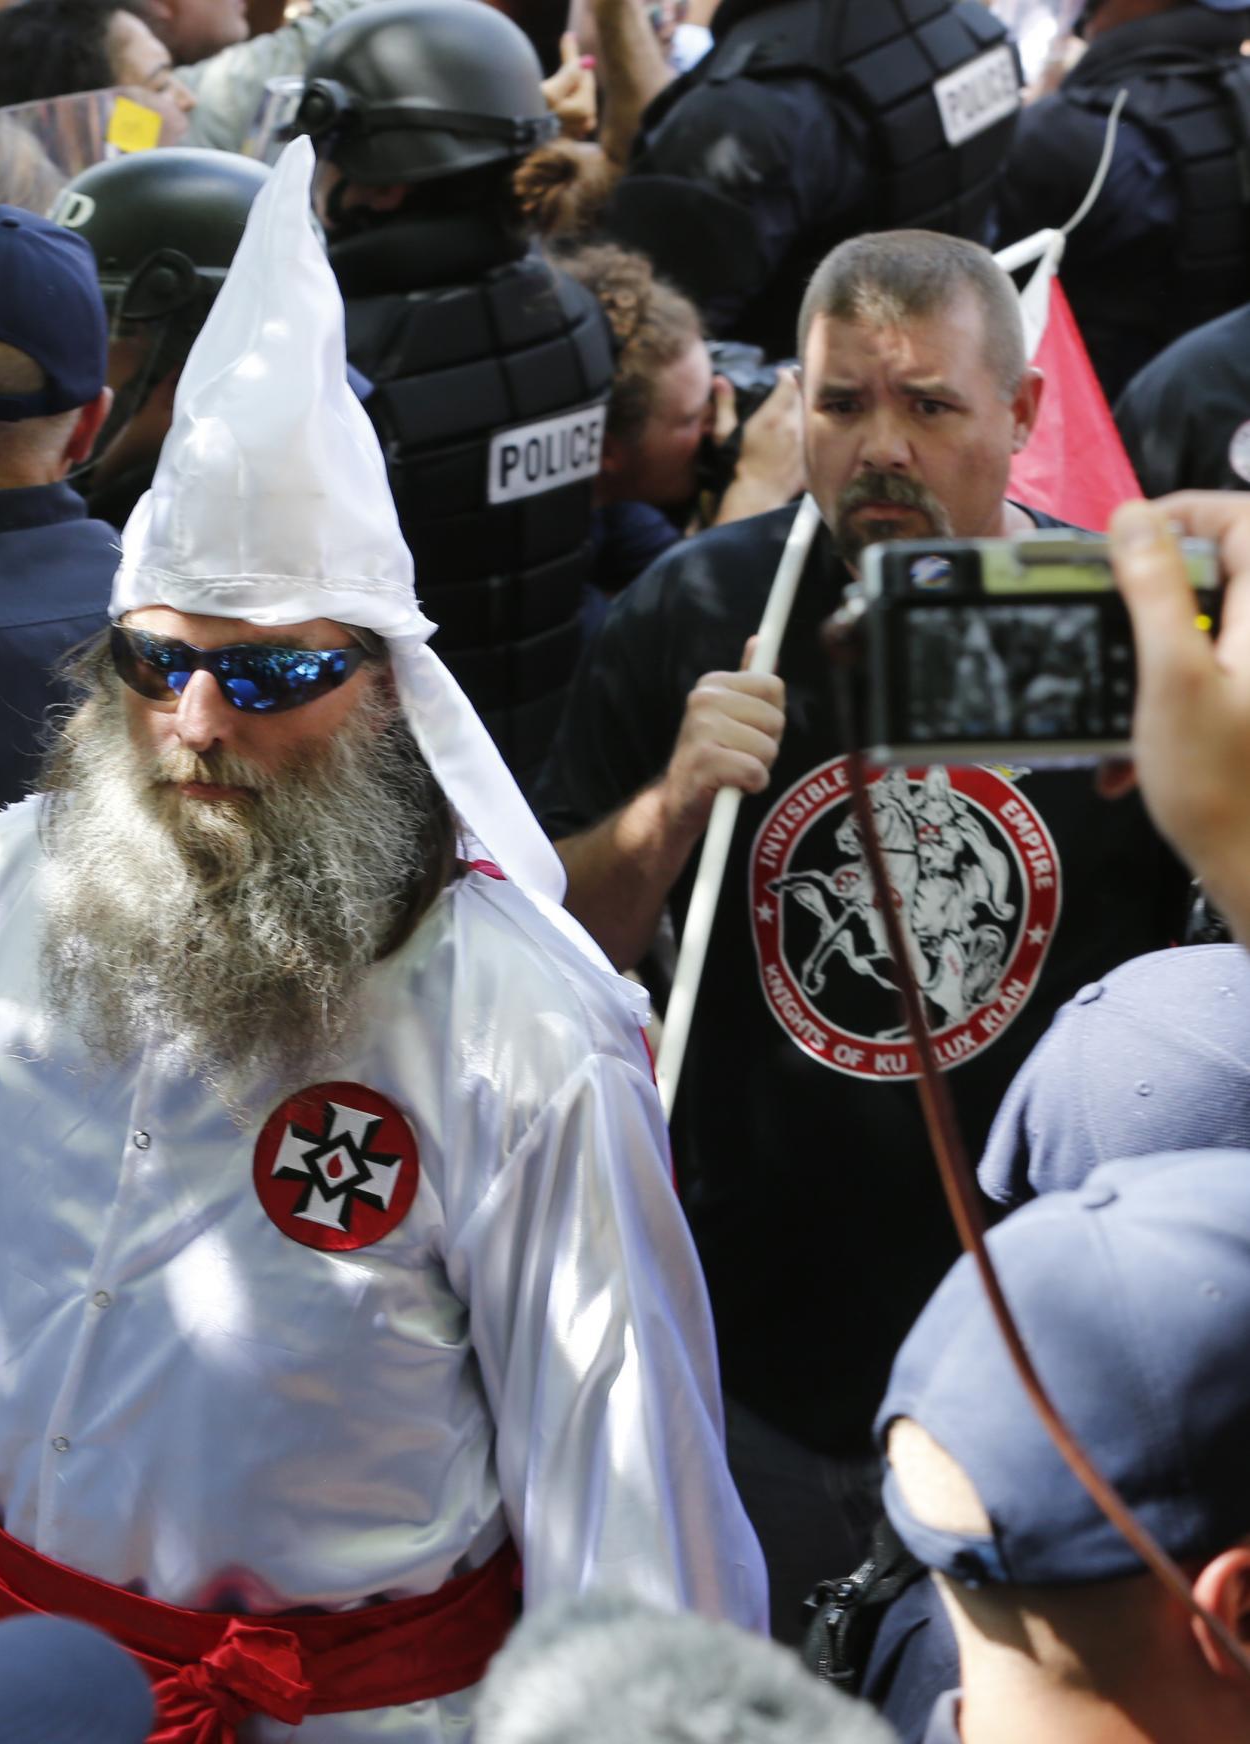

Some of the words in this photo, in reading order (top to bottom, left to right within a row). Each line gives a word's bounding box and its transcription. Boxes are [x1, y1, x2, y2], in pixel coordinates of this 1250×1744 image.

[500, 421, 599, 488] POLICE
[759, 766, 849, 870] INVISIBLE
[999, 799, 1054, 891] EMPIRE
[765, 963, 829, 1051] KNIGHTS
[833, 1044, 865, 1067] OF
[874, 1053, 908, 1073] KU
[933, 1030, 978, 1064] LUX
[979, 978, 1026, 1034] KLAN
